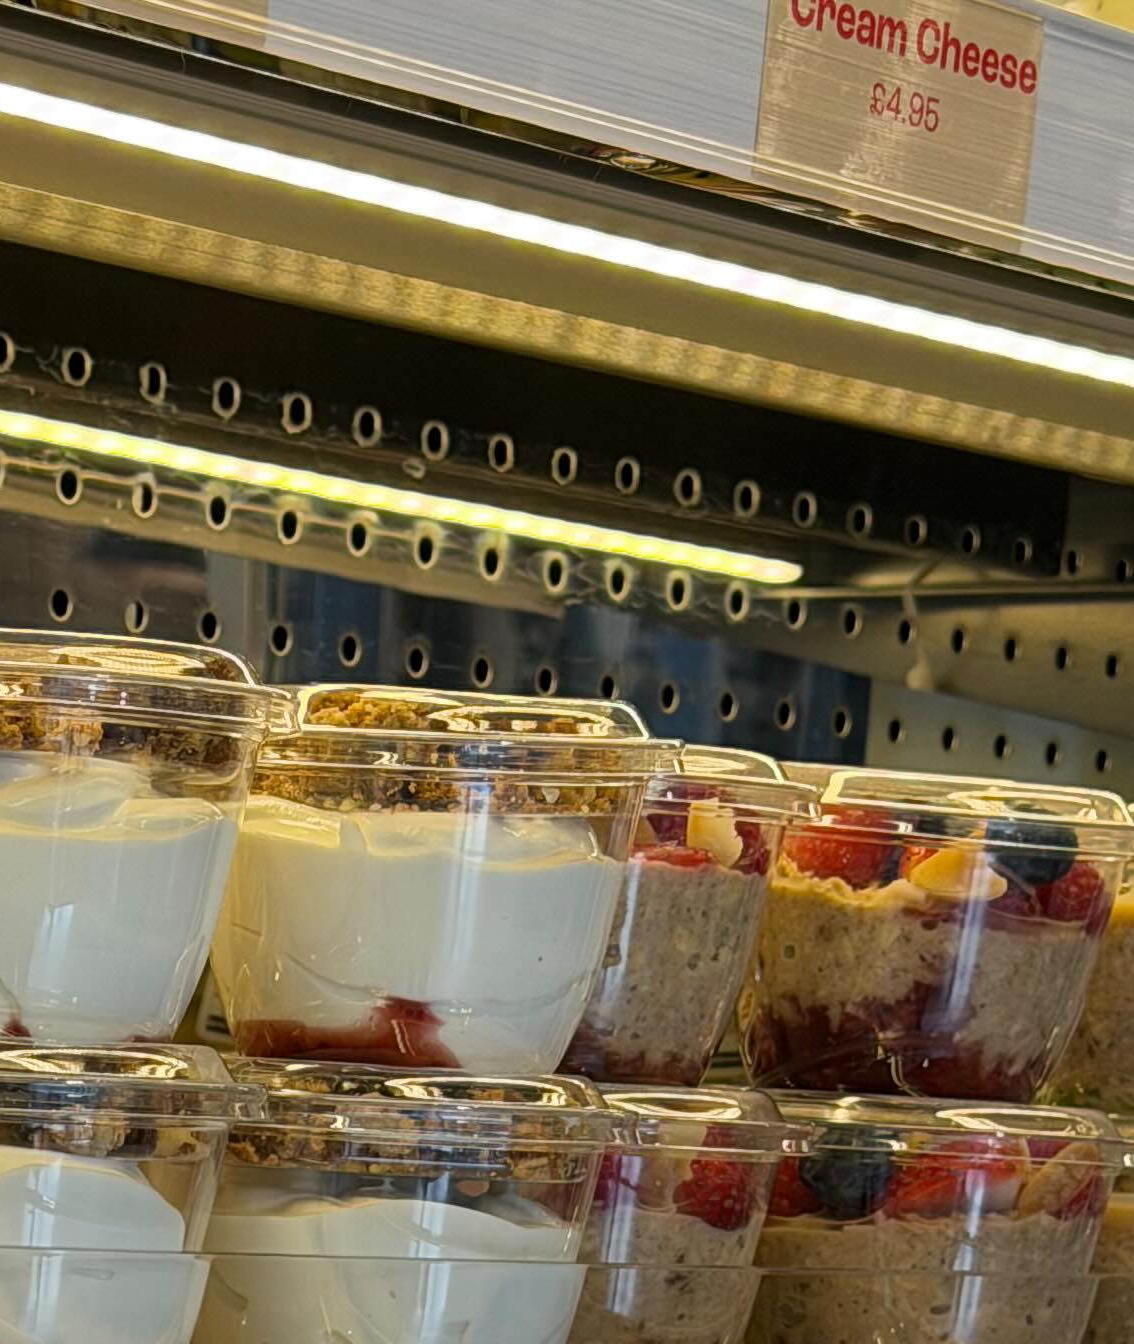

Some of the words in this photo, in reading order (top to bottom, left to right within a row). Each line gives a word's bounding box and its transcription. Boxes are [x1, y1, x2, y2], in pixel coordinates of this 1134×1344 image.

[791, 0, 908, 57] Cream
[916, 19, 1038, 94] Cheese
[869, 82, 940, 132] £4.95
